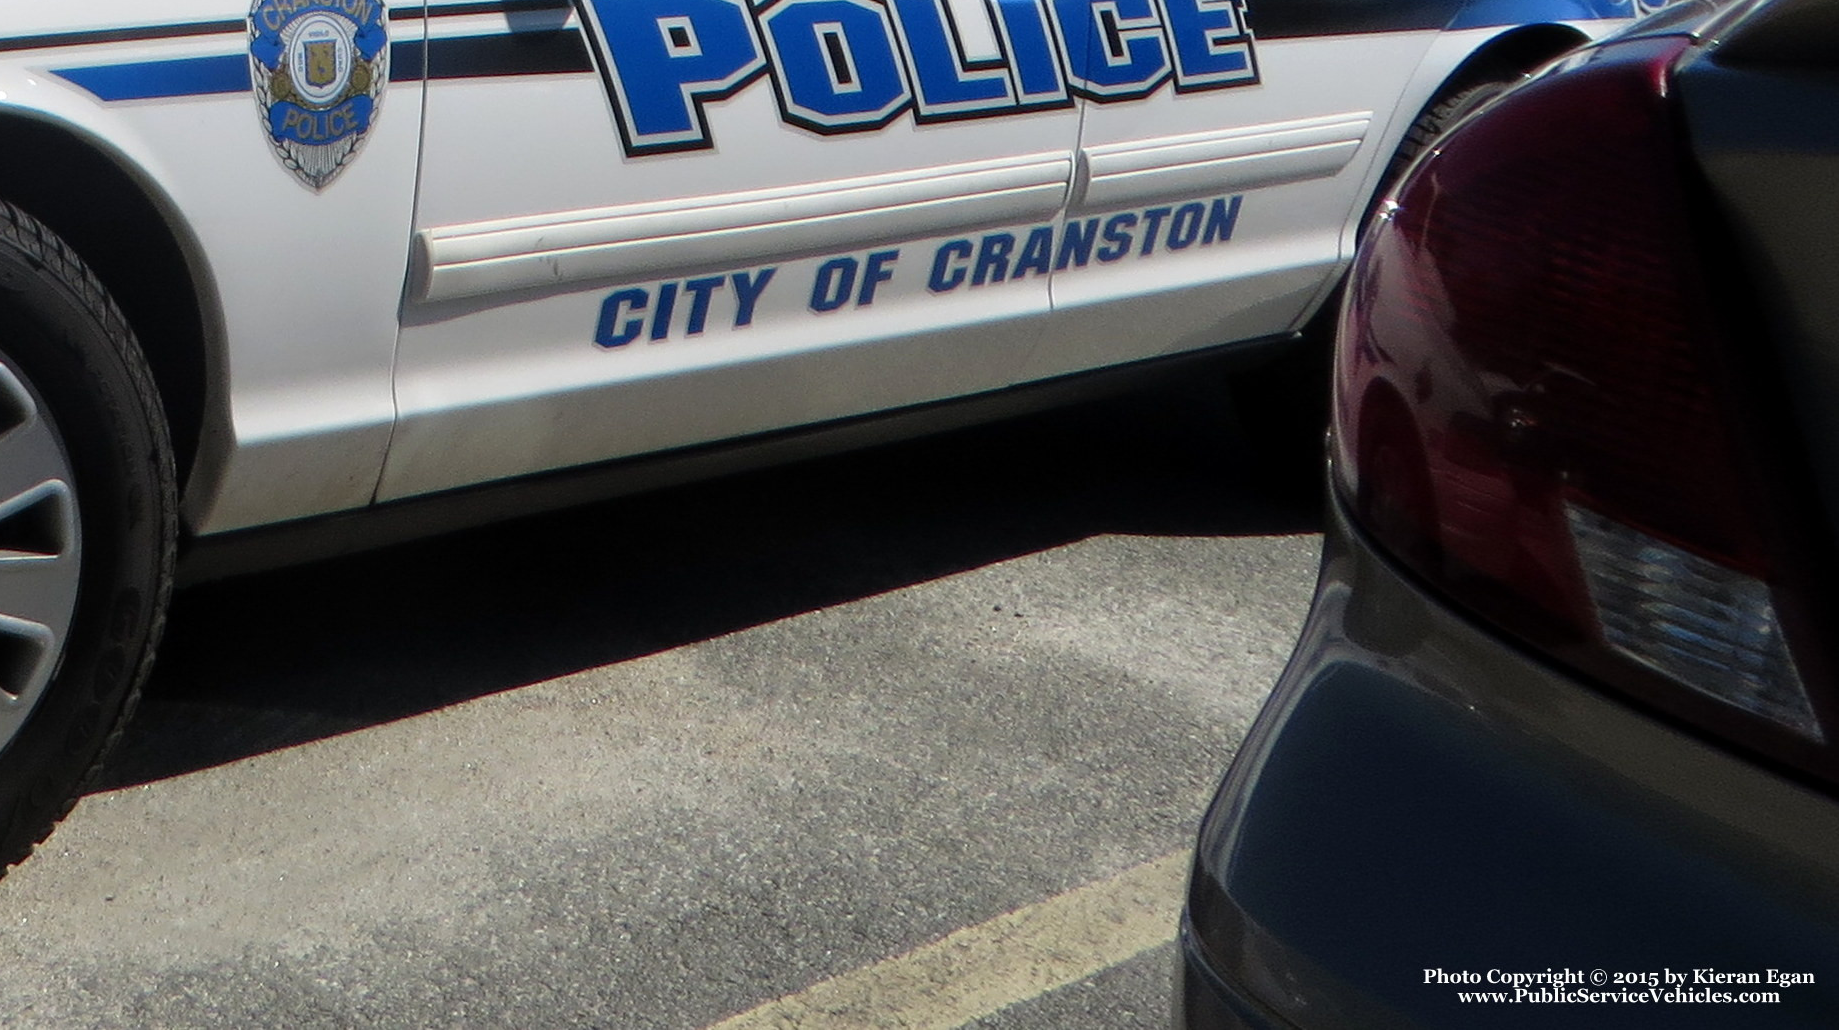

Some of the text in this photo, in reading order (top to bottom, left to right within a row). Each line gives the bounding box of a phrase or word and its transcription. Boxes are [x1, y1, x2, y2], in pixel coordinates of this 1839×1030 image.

[282, 102, 360, 141] POLICE
[593, 194, 1245, 349] CITY OF CRANSTON
